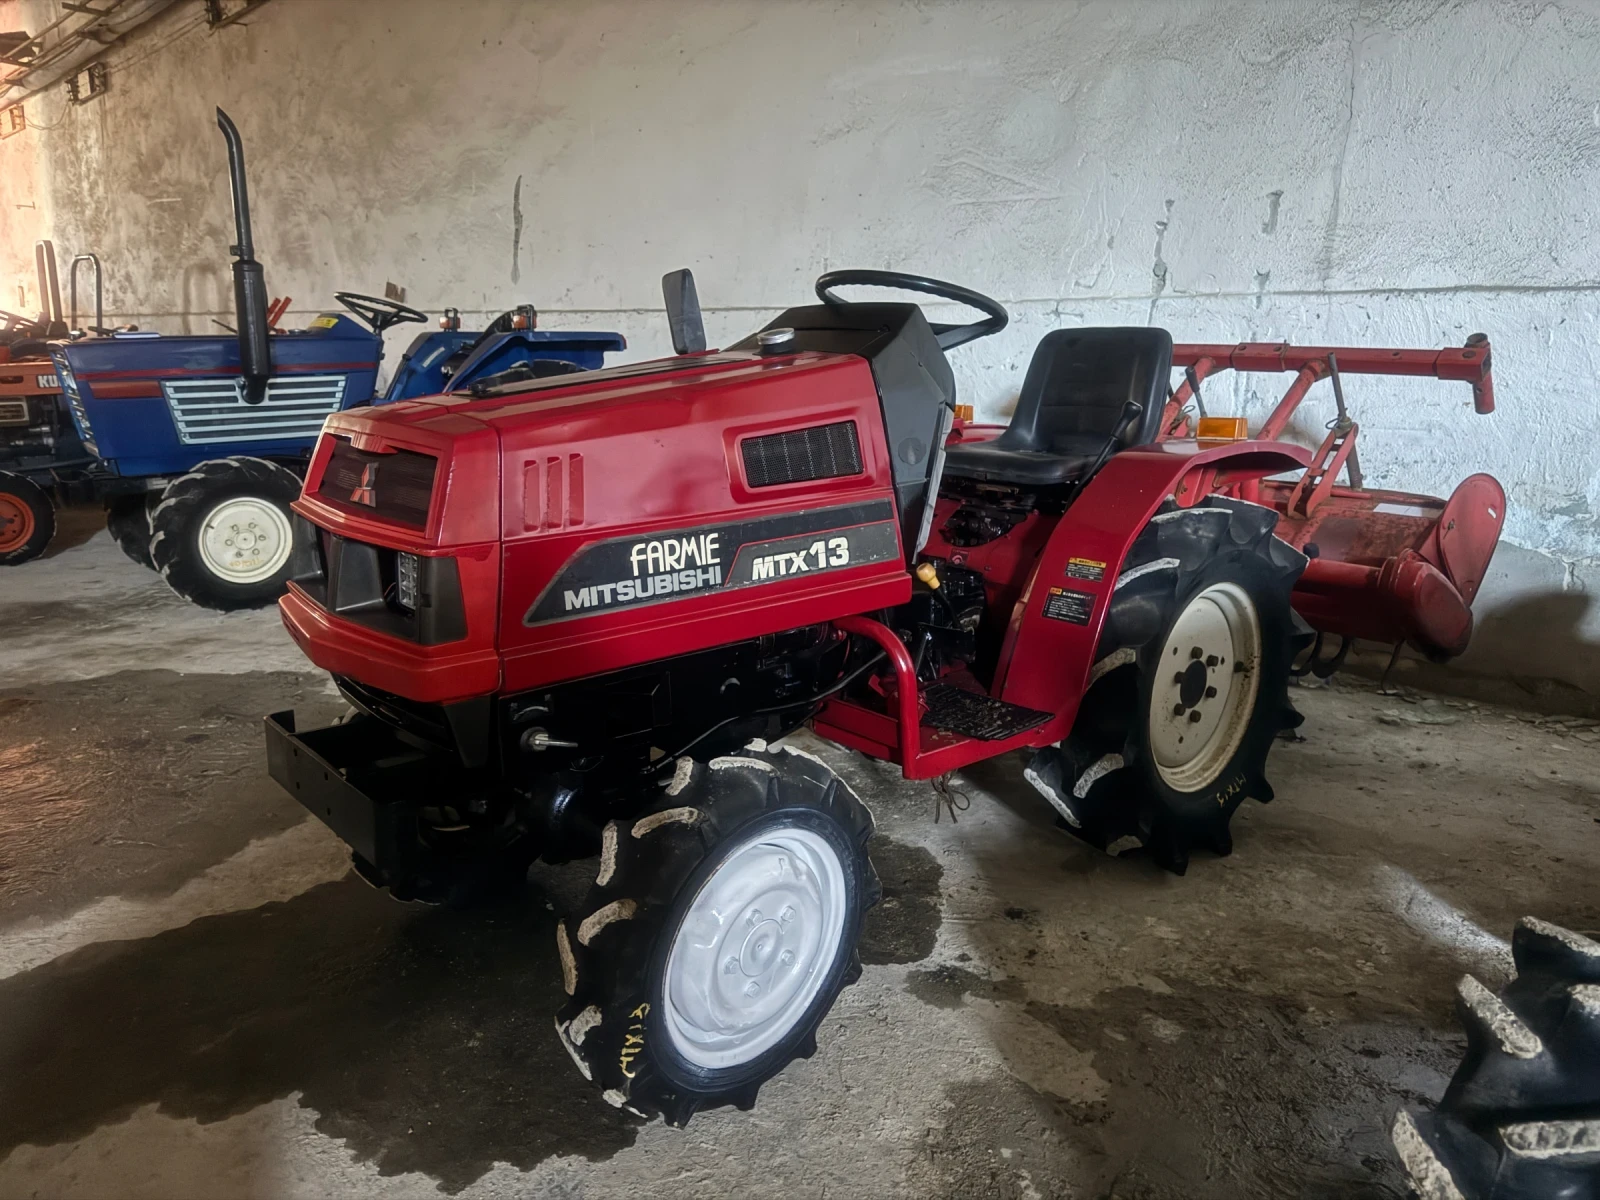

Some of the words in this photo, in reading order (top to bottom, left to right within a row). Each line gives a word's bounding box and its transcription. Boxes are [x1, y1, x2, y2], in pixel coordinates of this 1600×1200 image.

[630, 533, 721, 576] FARMIE
[752, 536, 850, 581] MTX13
[563, 565, 722, 611] MITSUBISHI
